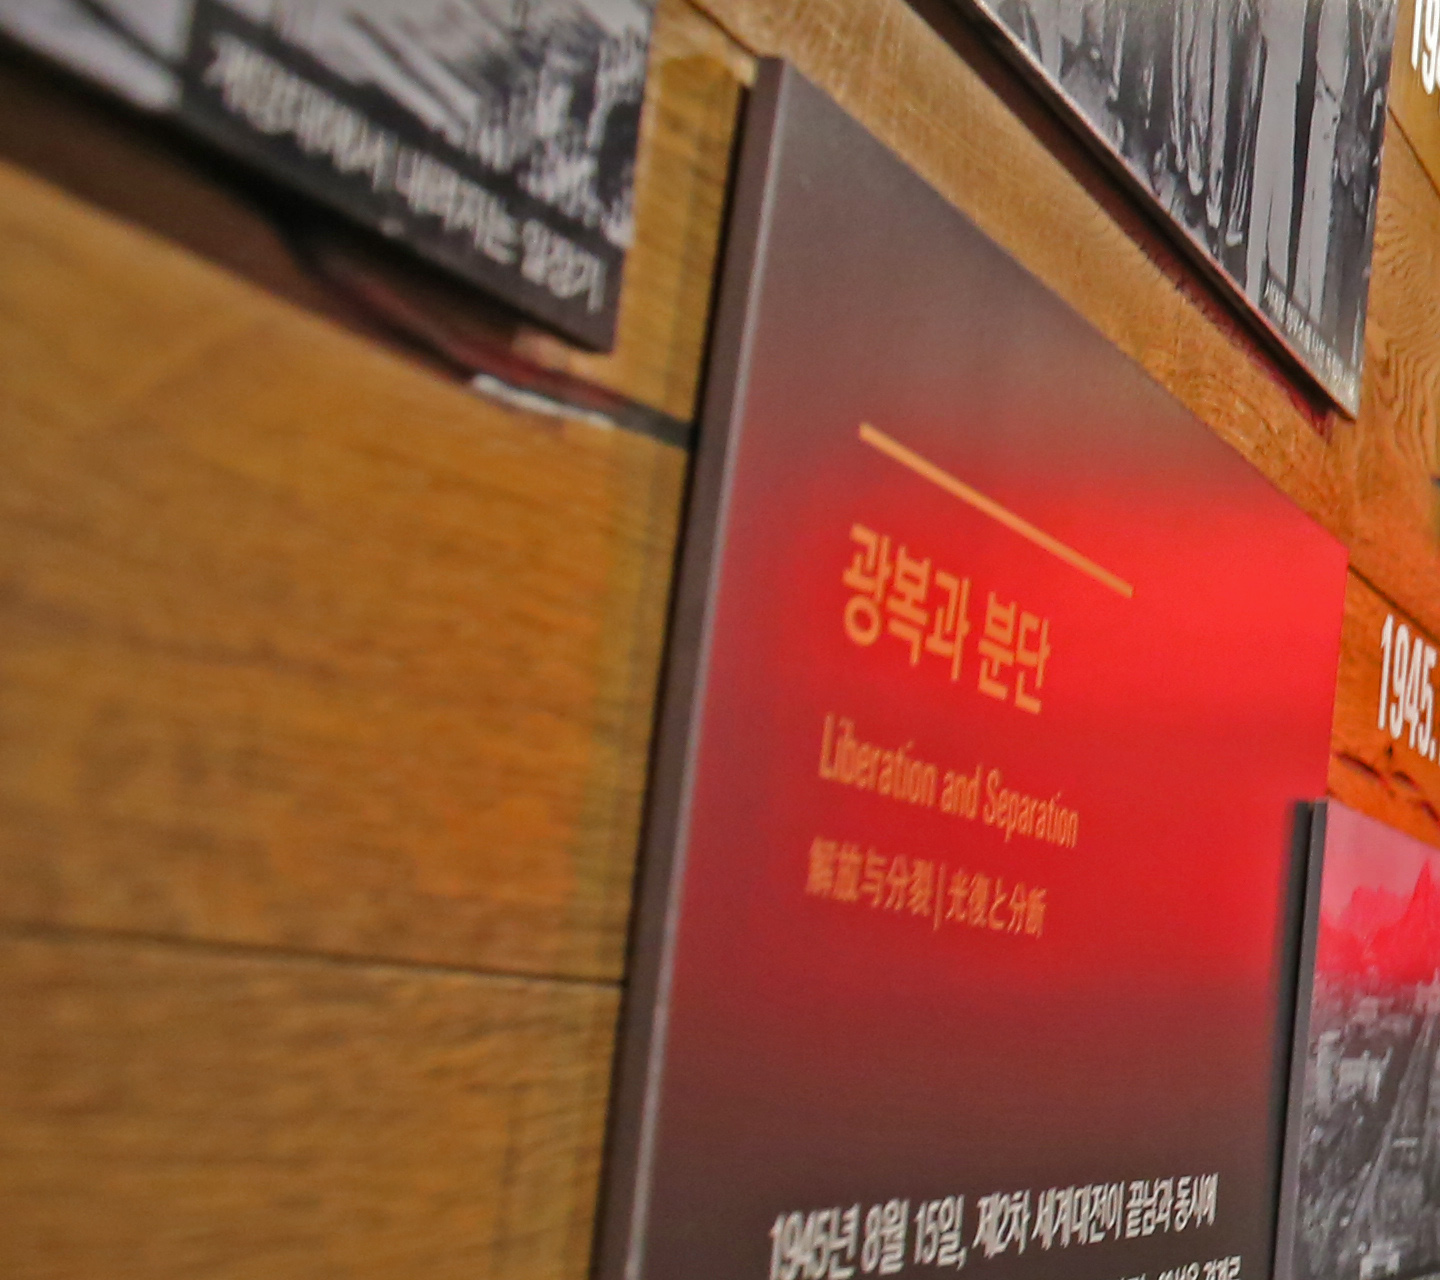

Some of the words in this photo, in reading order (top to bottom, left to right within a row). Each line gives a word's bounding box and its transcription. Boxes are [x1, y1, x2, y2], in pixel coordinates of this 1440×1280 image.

[842, 523, 970, 682] 광복과
[977, 590, 1051, 715] 분단
[818, 712, 937, 810] Liberation
[941, 763, 981, 823] and
[981, 767, 1080, 850] Separation
[861, 1198, 910, 1277] 8월
[914, 1193, 969, 1270] 15일,
[971, 1189, 1031, 1260] 제2차
[1031, 1180, 1125, 1252] 세계대전이
[1125, 1176, 1175, 1240] 끝남과
[1174, 1172, 1219, 1234] 동시에
